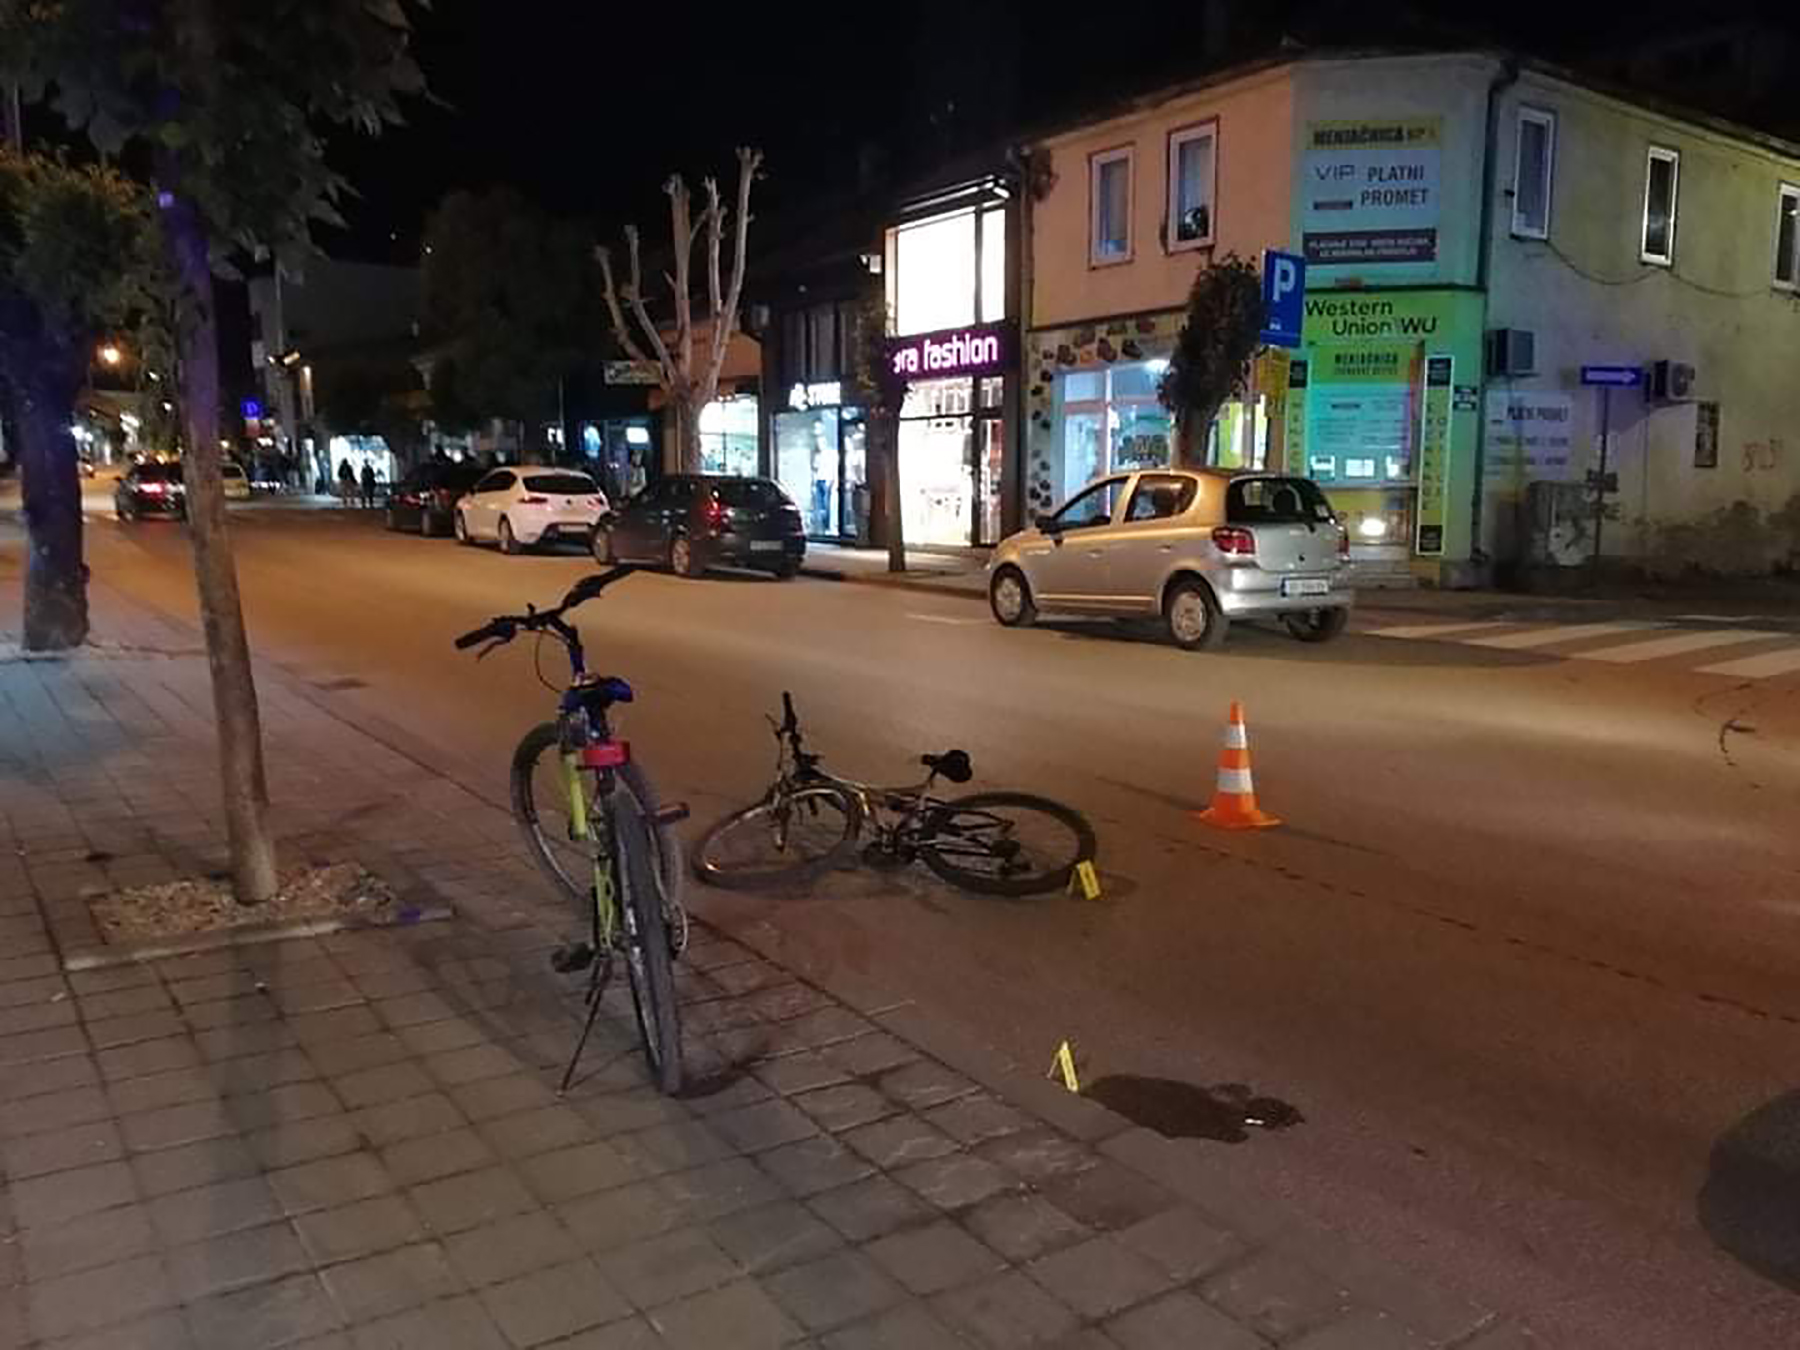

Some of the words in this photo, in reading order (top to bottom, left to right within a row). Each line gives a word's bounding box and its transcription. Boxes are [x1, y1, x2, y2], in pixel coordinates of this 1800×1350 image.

[1315, 164, 1355, 181] VIP
[1367, 164, 1425, 183] PLATNI
[1360, 188, 1430, 206] PROMET
[1272, 257, 1296, 302] P
[1305, 299, 1393, 317] Western
[1331, 310, 1391, 336] Union
[1400, 316, 1438, 335] WU
[923, 333, 998, 371] fashion
